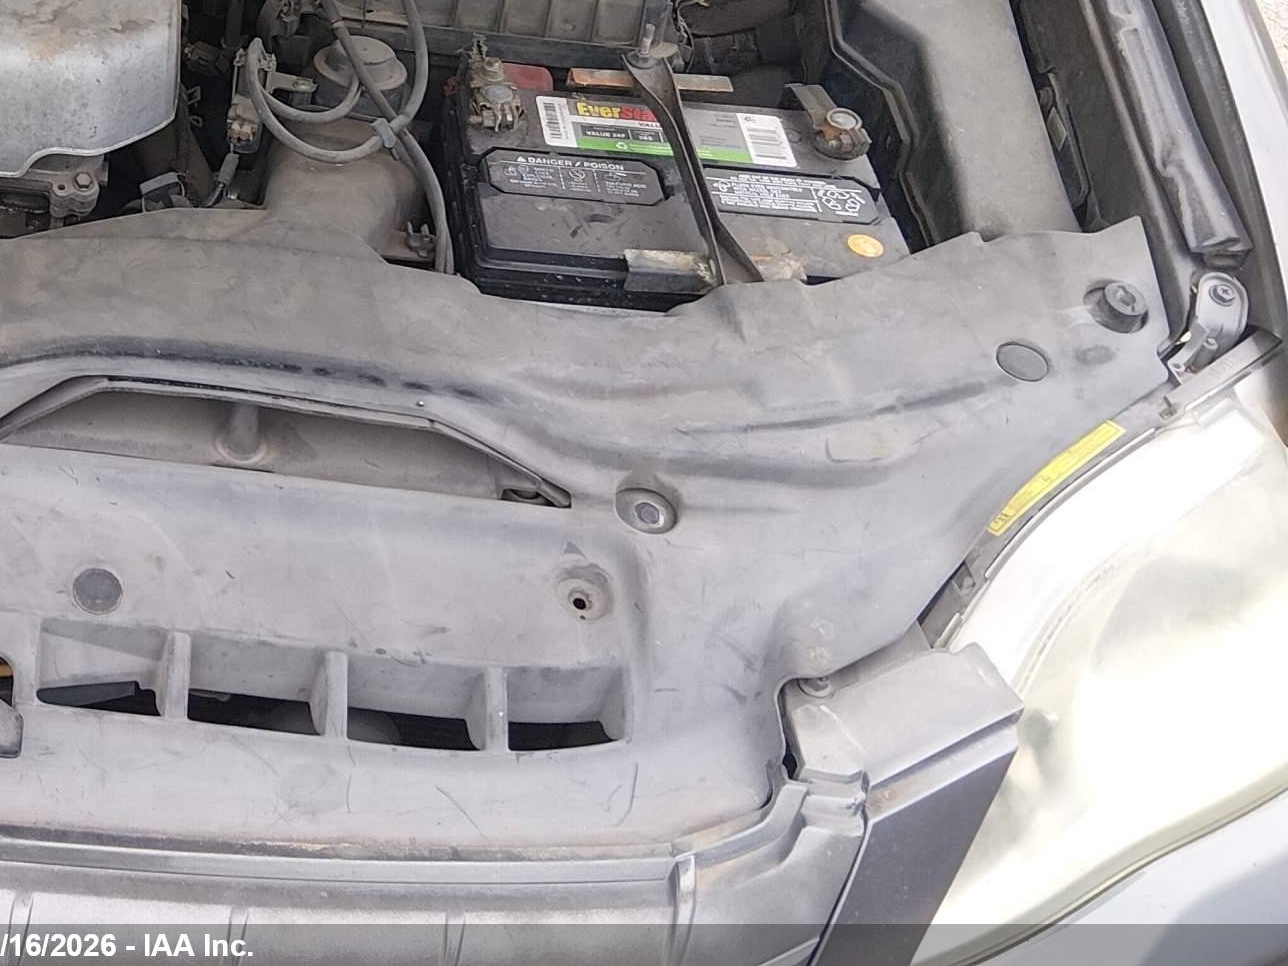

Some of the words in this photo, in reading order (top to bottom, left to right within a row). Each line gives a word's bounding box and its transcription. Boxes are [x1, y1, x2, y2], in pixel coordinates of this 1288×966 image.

[575, 100, 658, 123] EverSta
[638, 121, 662, 129] VALU
[527, 156, 573, 167] DANGER
[583, 161, 625, 171] POISON
